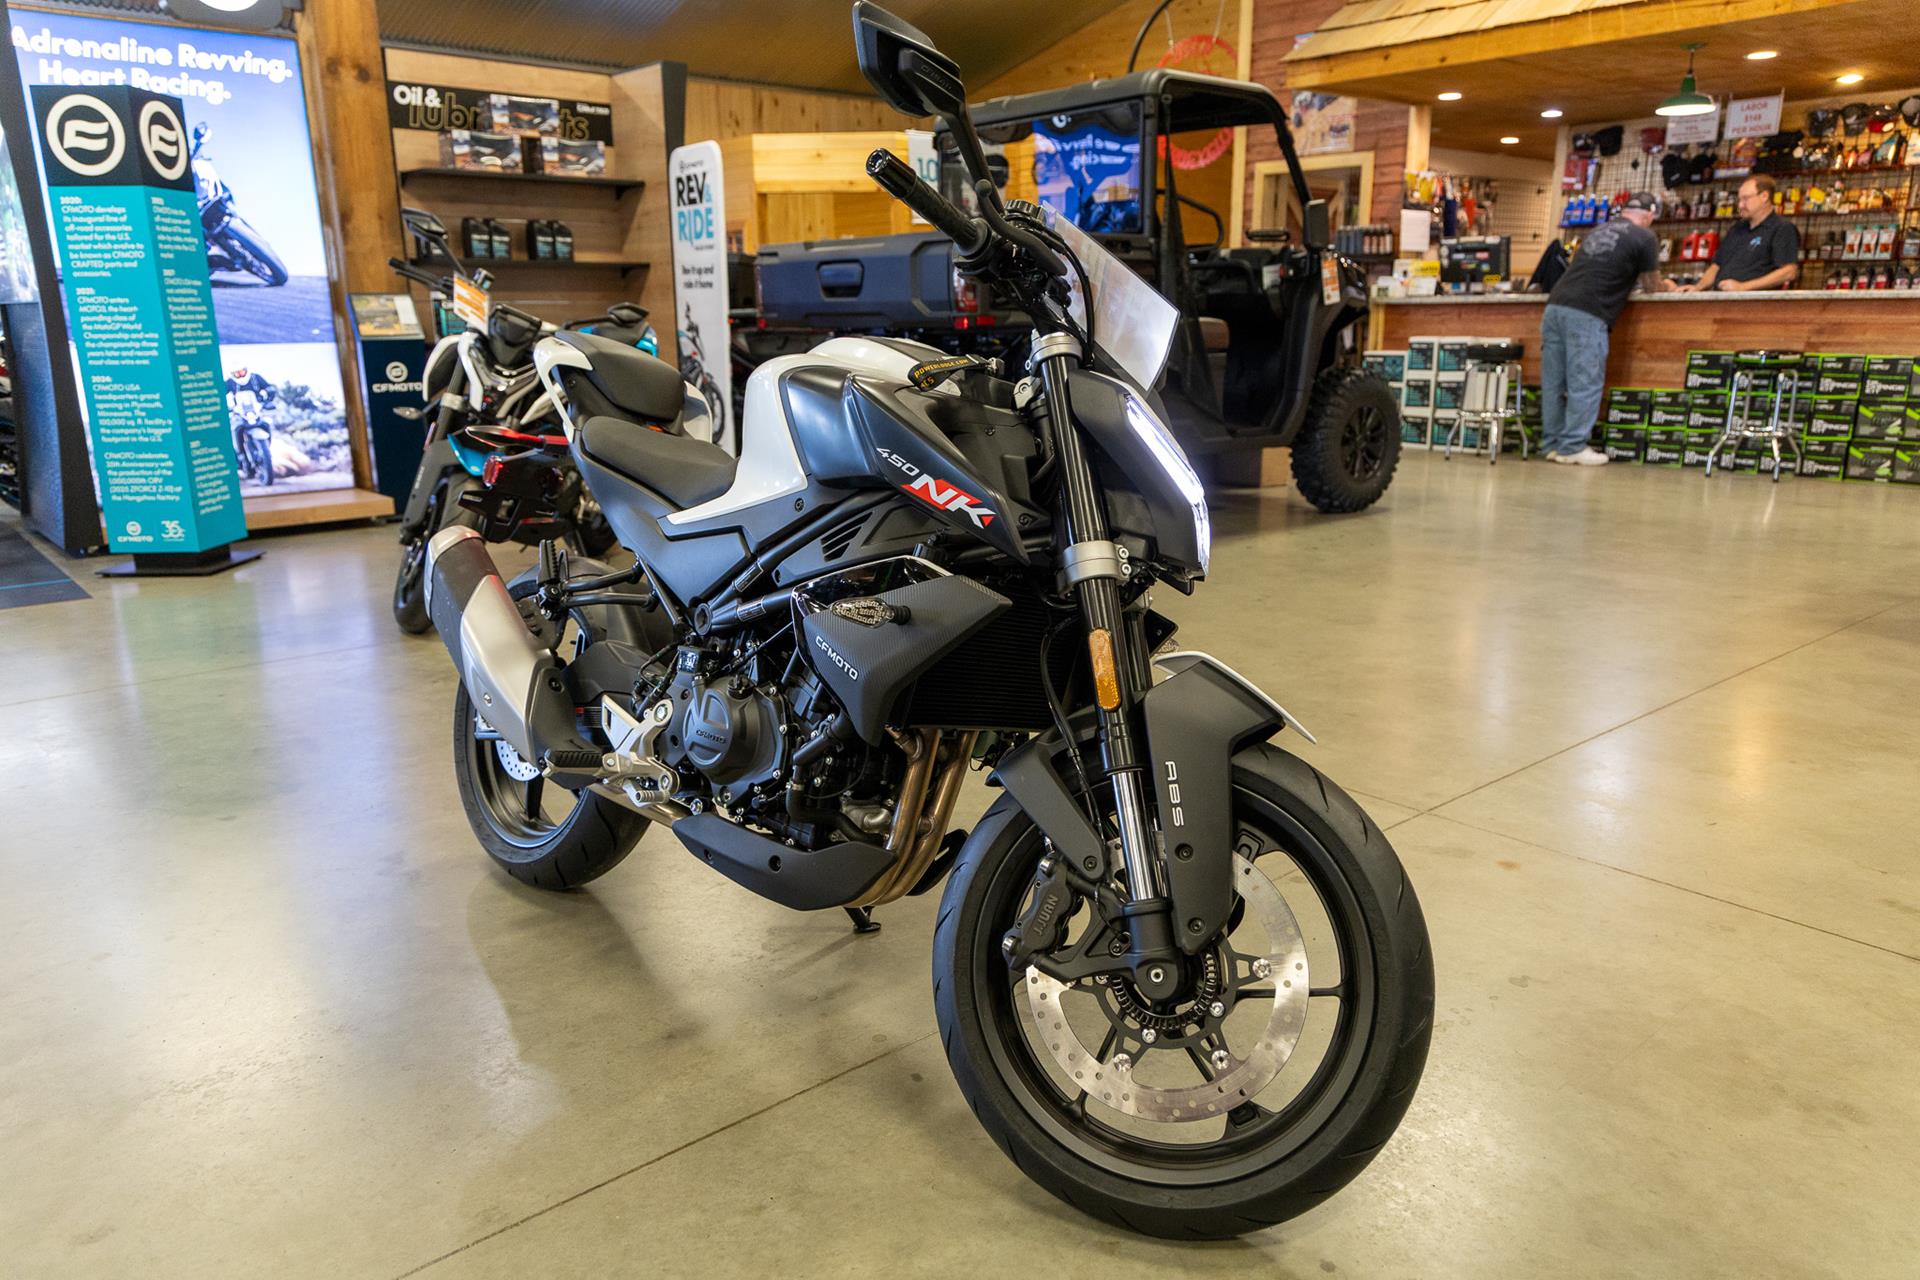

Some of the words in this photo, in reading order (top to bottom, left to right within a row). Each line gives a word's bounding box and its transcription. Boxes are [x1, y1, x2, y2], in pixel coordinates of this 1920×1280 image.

[11, 26, 173, 66] Adrenaline
[178, 43, 293, 83] Revving.
[39, 59, 127, 86] Heart
[131, 67, 232, 105] Racing.
[393, 85, 423, 107] Oil
[424, 87, 441, 108] &
[676, 171, 706, 207] REV
[678, 206, 714, 246] RIDE
[372, 381, 423, 394] CFMOTO
[876, 447, 920, 477] 450
[910, 473, 997, 529] NK
[815, 635, 859, 681] CFMOTO
[1165, 760, 1185, 827] ABS
[1033, 894, 1059, 936] J.JUAN
